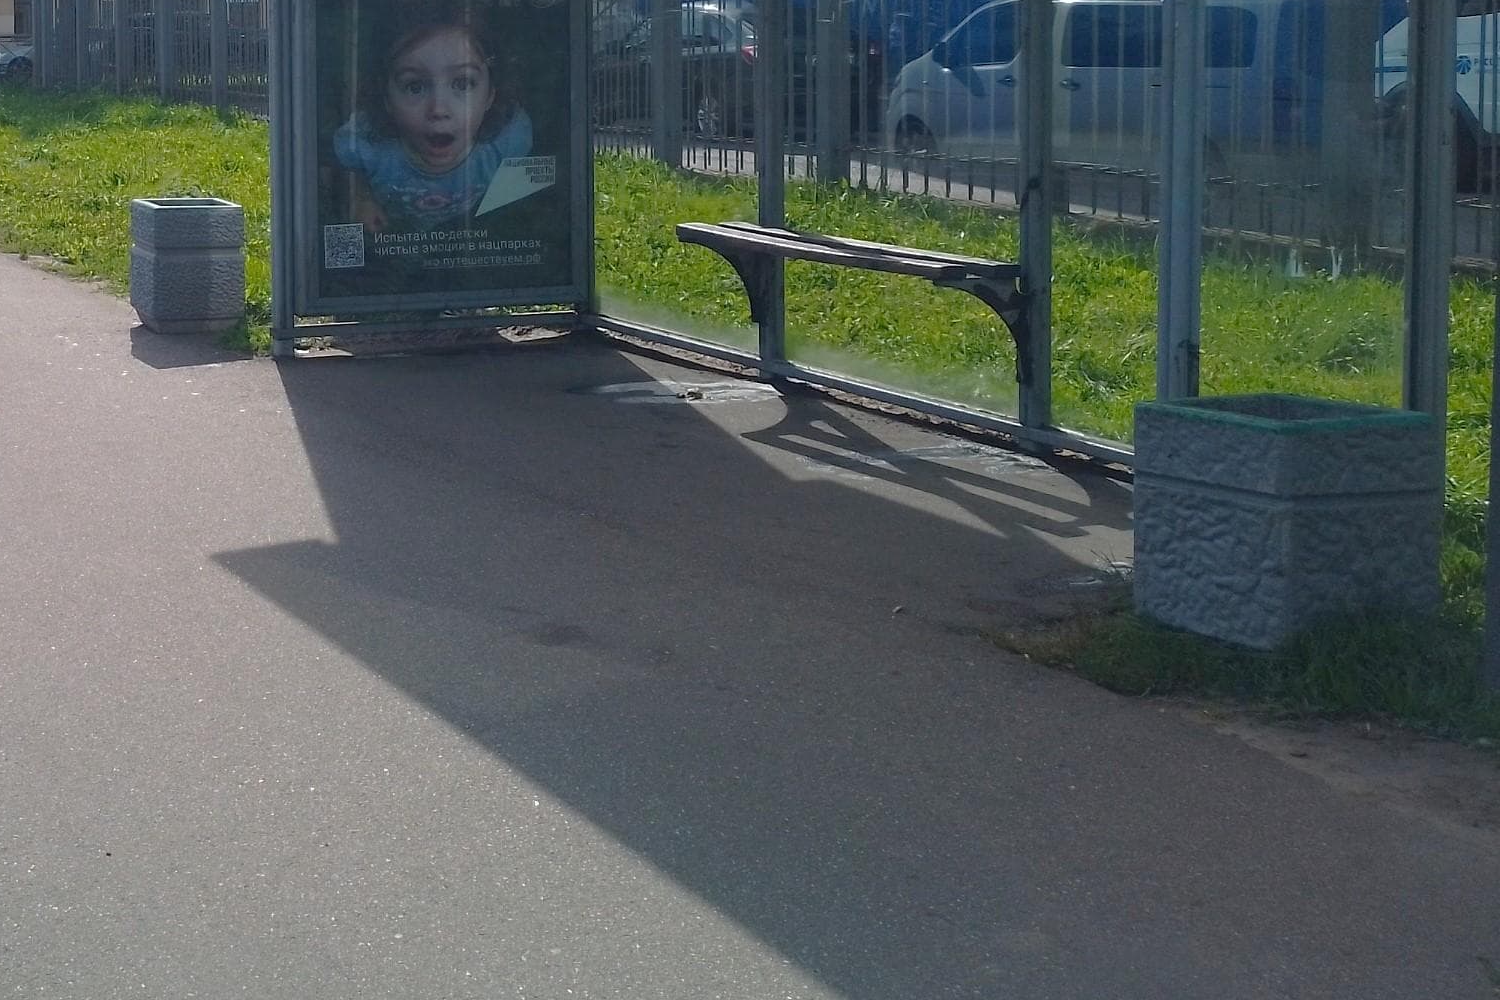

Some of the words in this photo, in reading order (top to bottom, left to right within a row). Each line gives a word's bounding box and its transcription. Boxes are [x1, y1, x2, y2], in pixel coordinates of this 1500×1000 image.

[373, 230, 427, 244] Испытай
[431, 228, 488, 242] по-детски
[374, 243, 419, 256] чистые
[422, 241, 466, 254] эмоции
[468, 241, 476, 251] в
[479, 238, 541, 252] нацпарках
